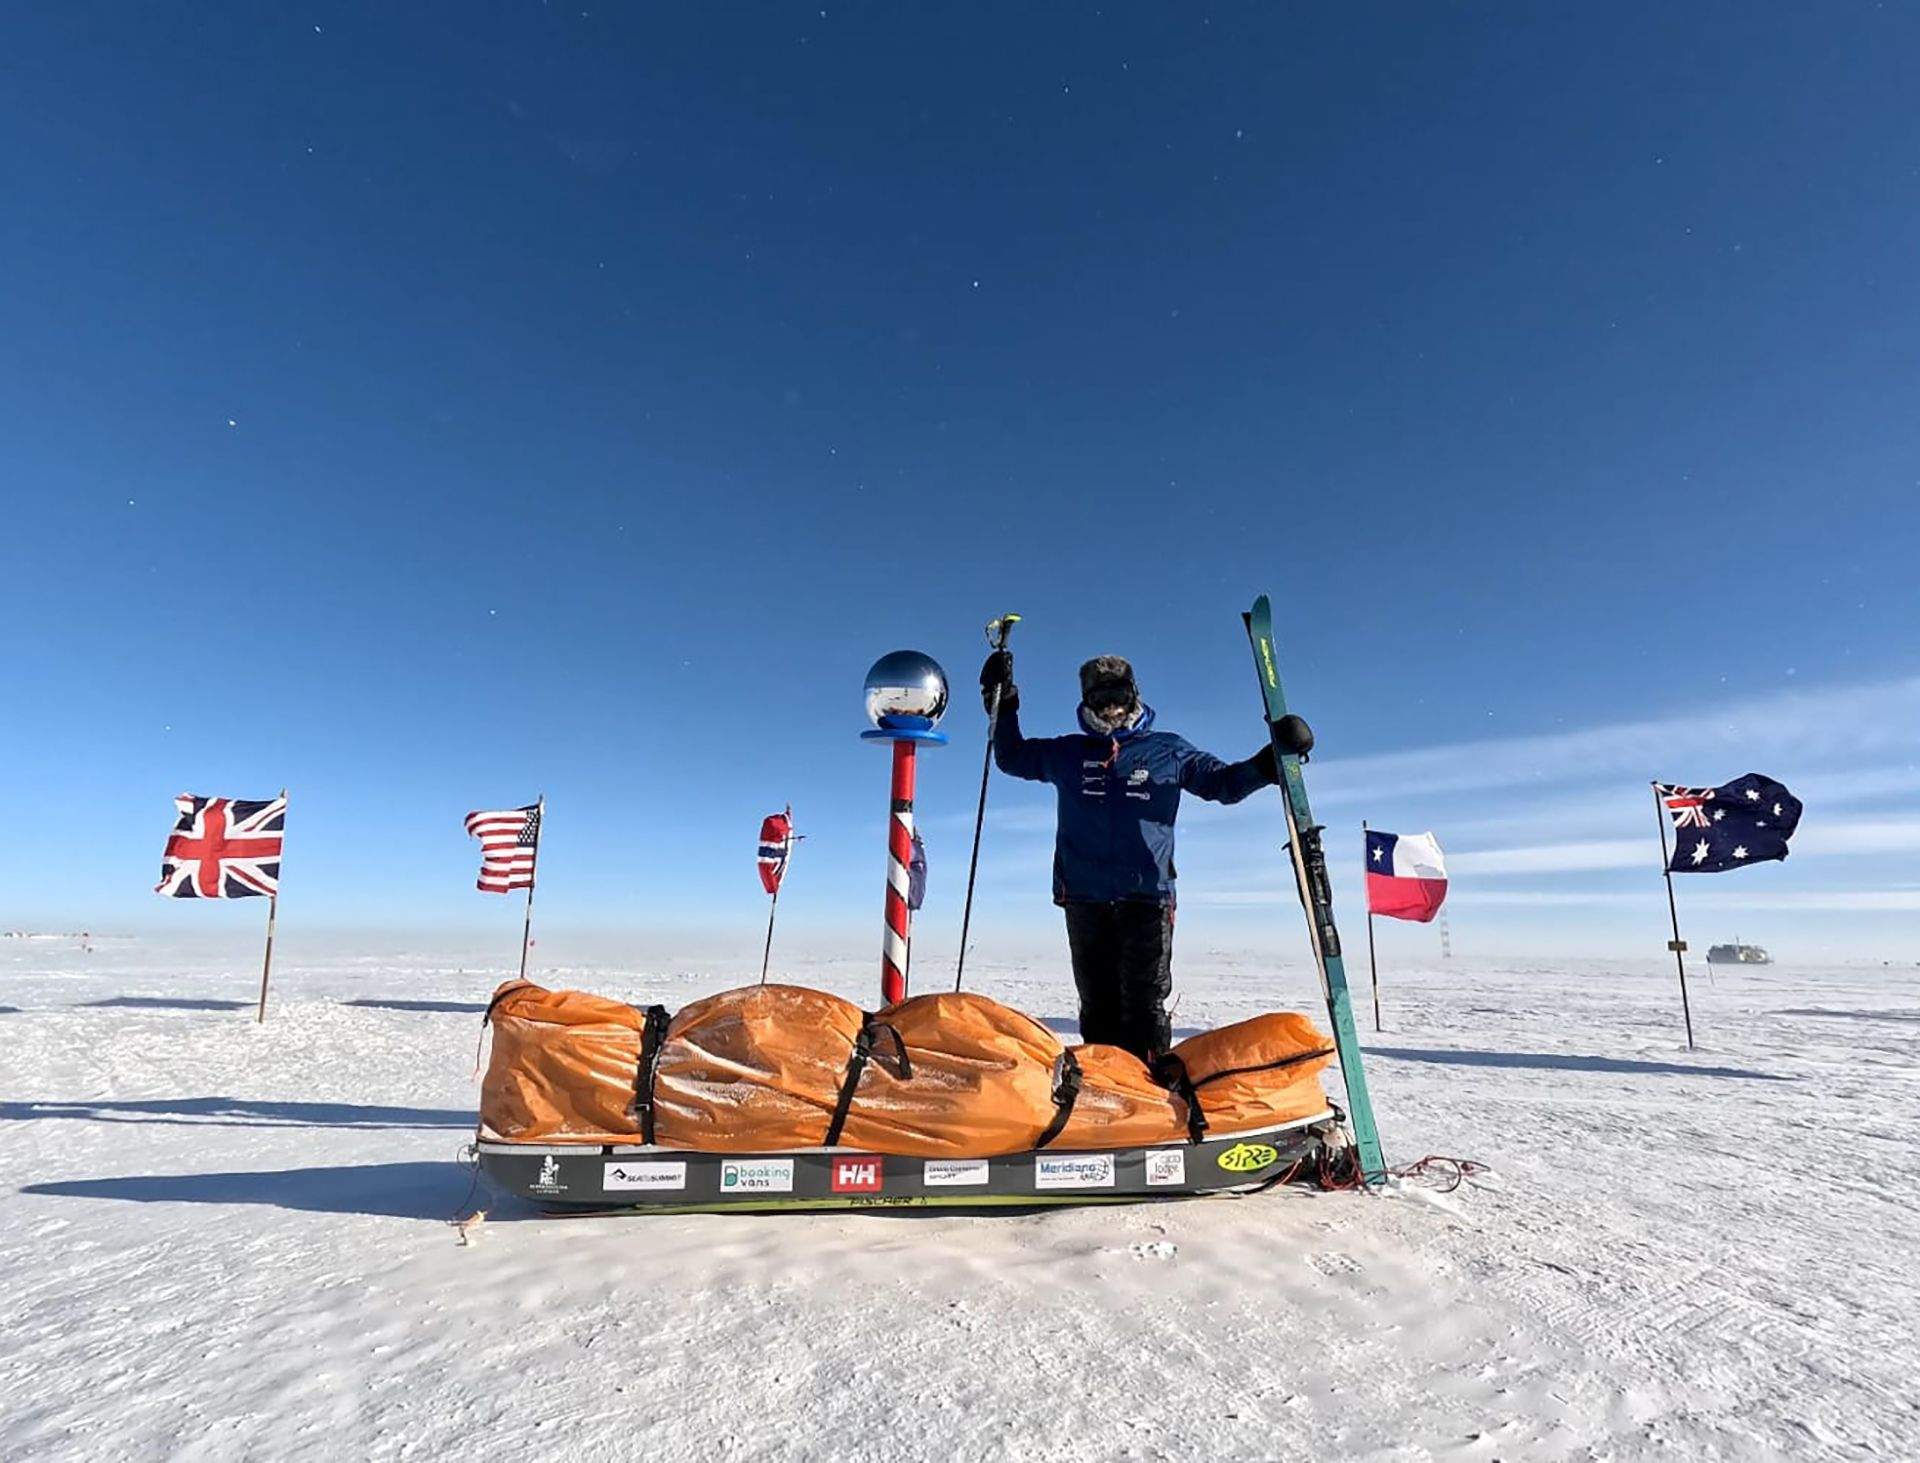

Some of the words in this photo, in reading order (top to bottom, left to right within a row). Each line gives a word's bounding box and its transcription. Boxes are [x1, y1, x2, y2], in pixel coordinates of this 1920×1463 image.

[740, 1165, 791, 1181] booking
[1040, 1161, 1096, 1174] Meridiano
[740, 1179, 770, 1187] vans
